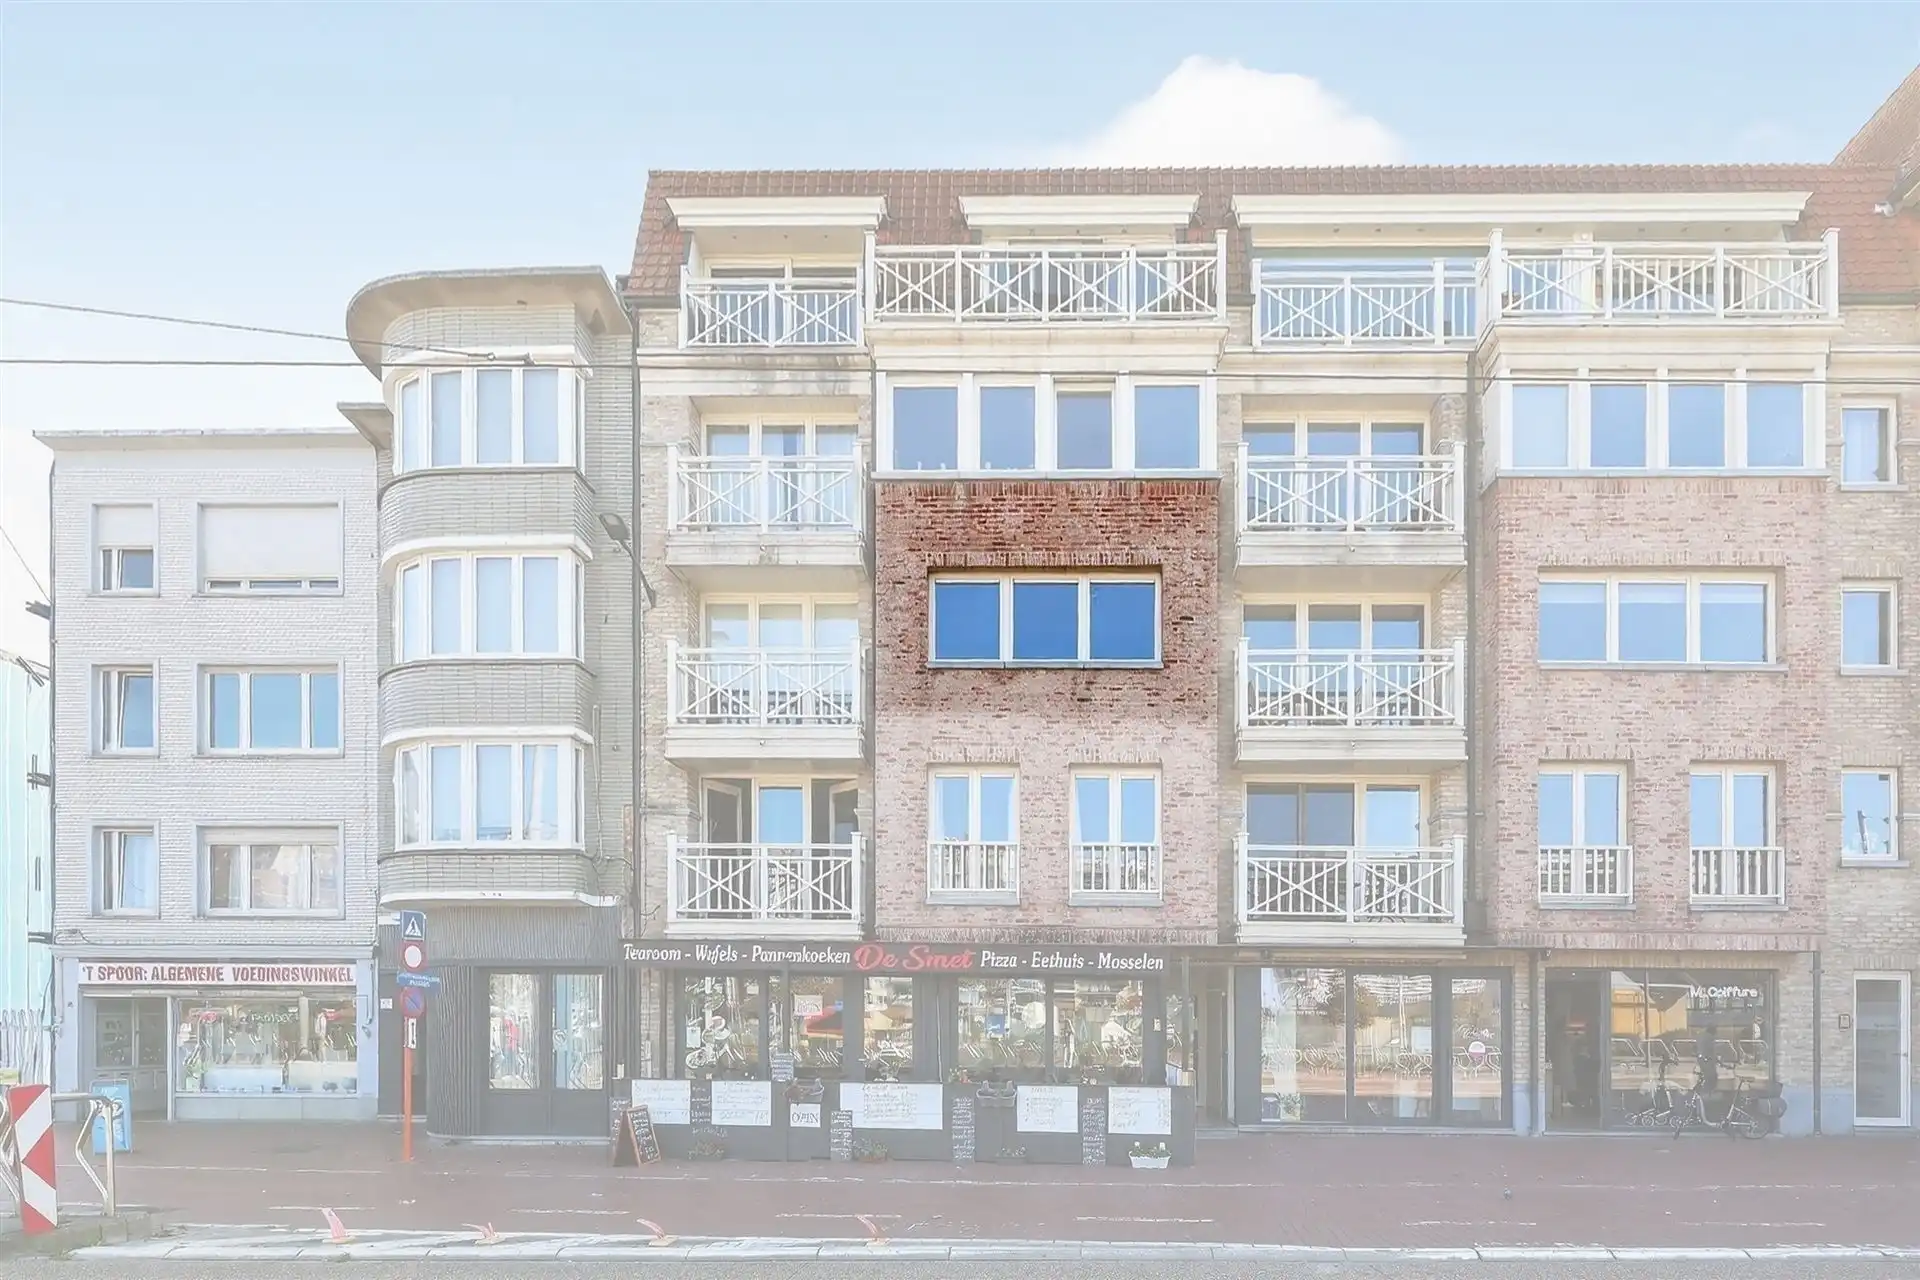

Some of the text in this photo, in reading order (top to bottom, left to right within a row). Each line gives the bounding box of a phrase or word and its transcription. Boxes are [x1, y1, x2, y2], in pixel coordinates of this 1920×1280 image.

[623, 944, 681, 962] Tearoom
[751, 945, 850, 964] Pannenkoeken
[853, 943, 899, 970] De
[902, 943, 976, 971] Smet
[980, 950, 1018, 968] Pizza
[1030, 951, 1084, 969] Eethuis
[1097, 952, 1164, 970] Mosselen
[151, 966, 224, 982] ALGEMENE
[232, 966, 354, 982] VOEDINGSWINKEL
[1707, 986, 1758, 998] Coiffure
